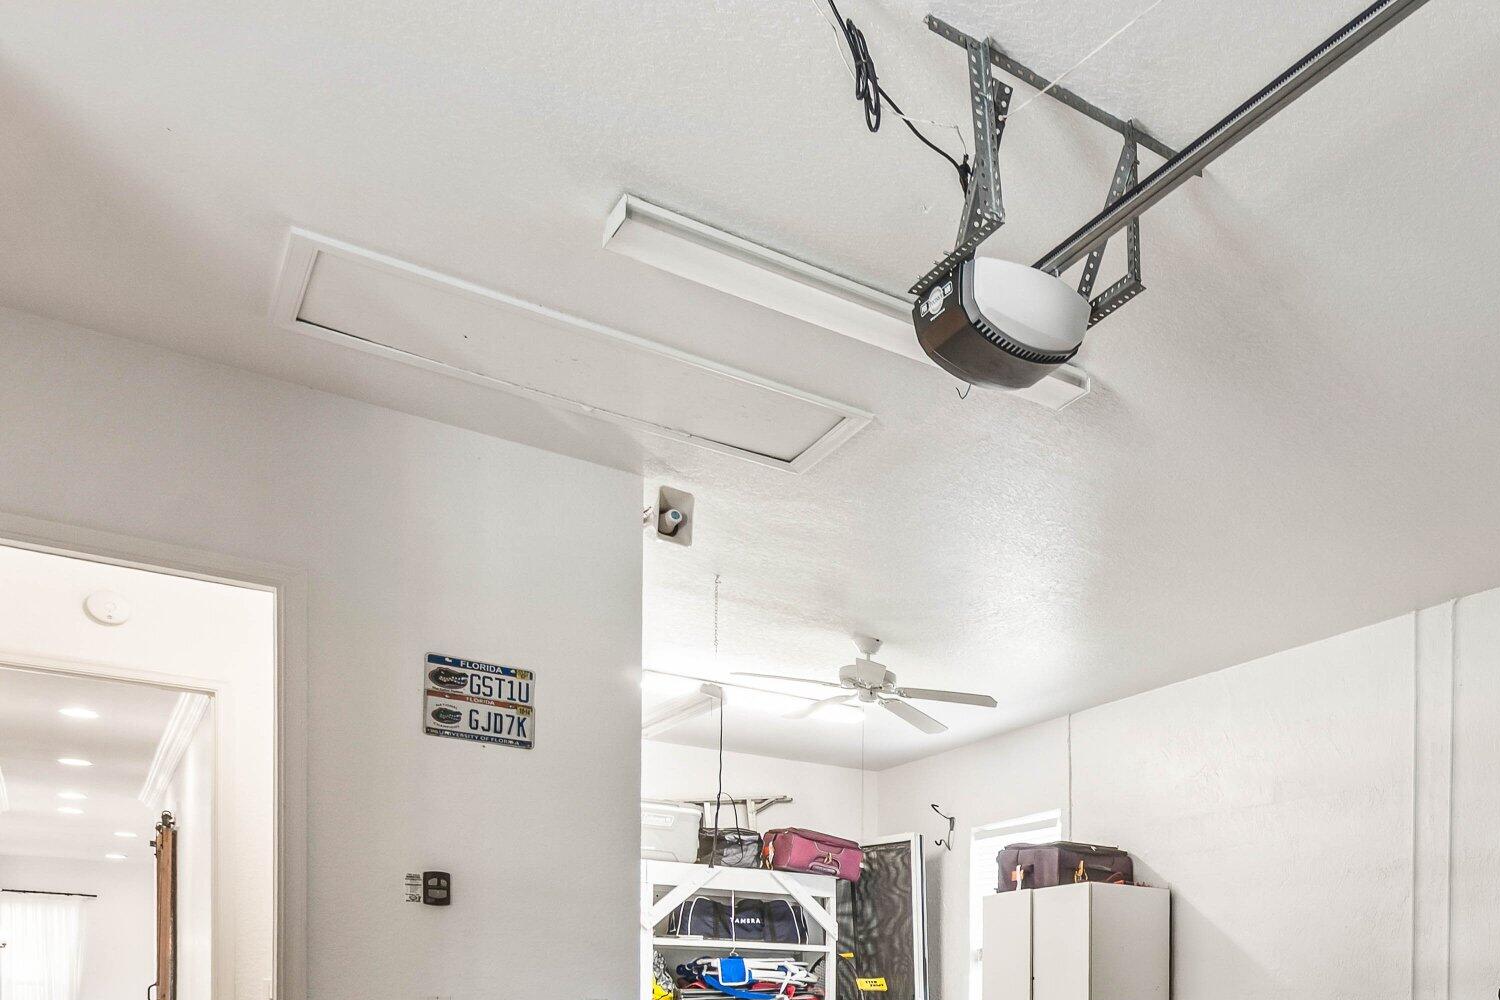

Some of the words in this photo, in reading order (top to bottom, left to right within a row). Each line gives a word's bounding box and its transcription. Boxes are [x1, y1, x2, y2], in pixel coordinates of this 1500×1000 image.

[460, 660, 503, 675] FLORIDA
[469, 673, 530, 703] GST1U
[469, 708, 527, 738] GJD7K
